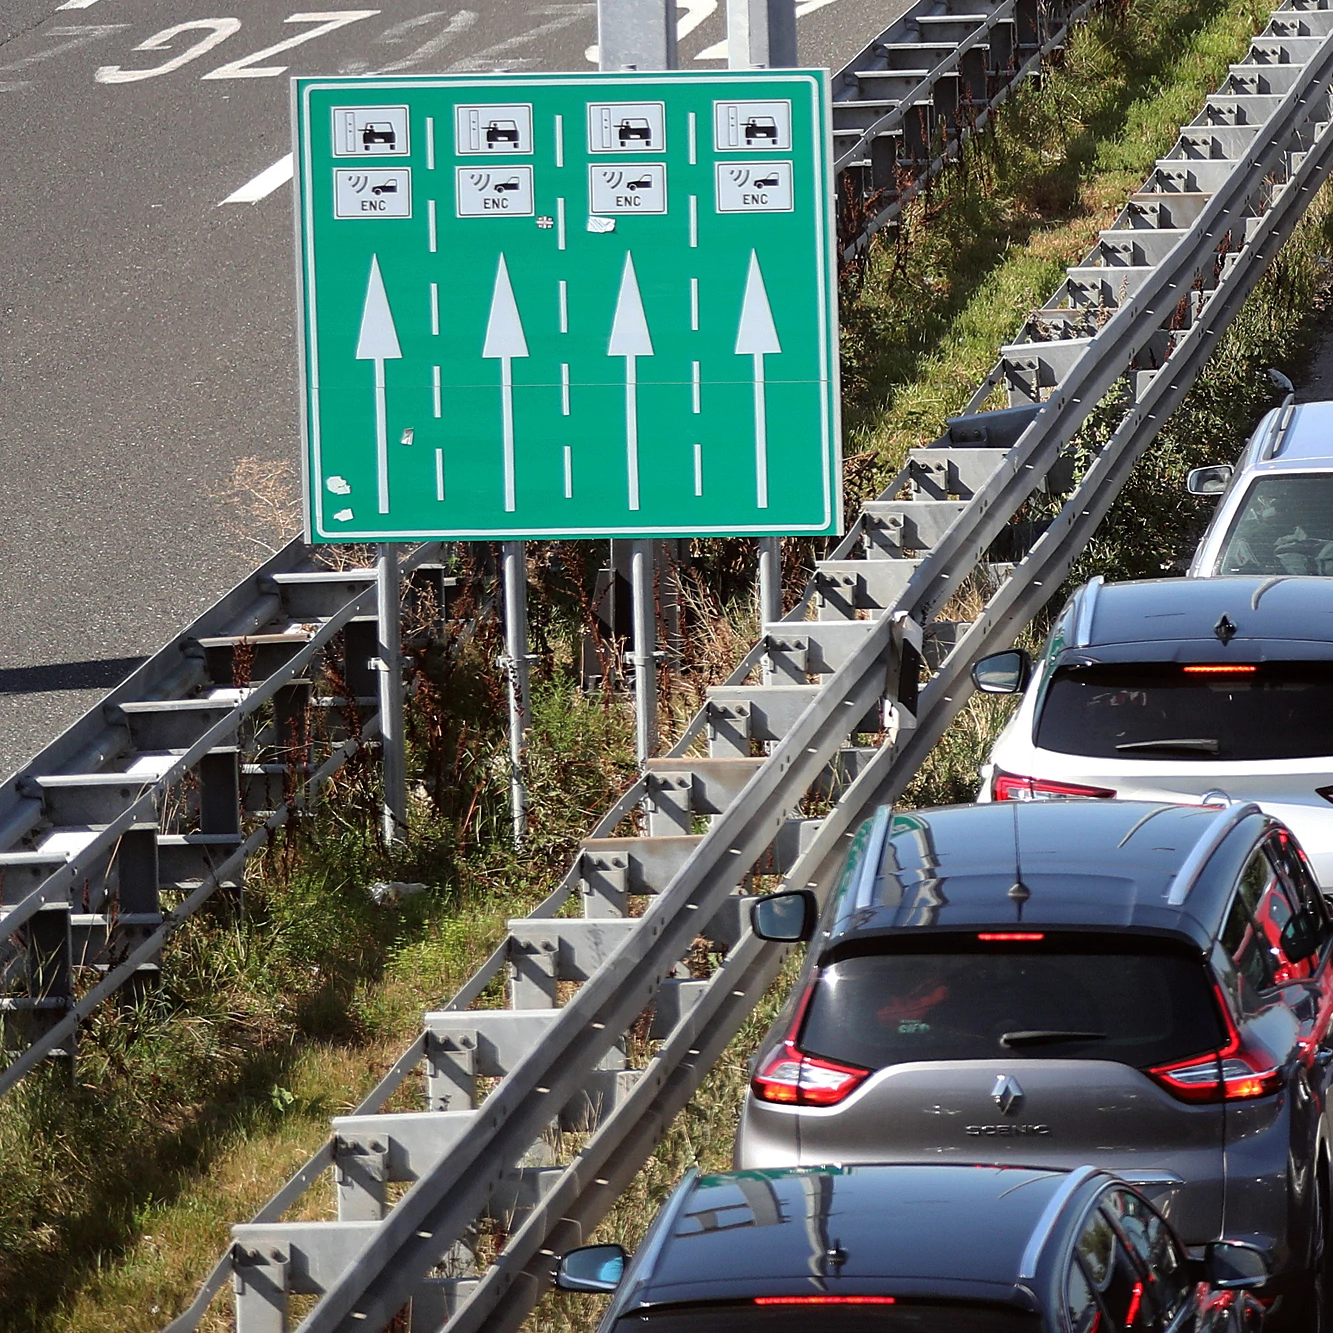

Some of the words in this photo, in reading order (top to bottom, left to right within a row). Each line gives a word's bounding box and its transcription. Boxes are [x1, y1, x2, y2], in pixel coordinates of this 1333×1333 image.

[360, 197, 387, 212] ENC
[482, 197, 509, 211] ENC
[615, 195, 642, 209] ENC
[742, 193, 769, 207] ENC
[965, 1124, 1050, 1136] SCENIC
